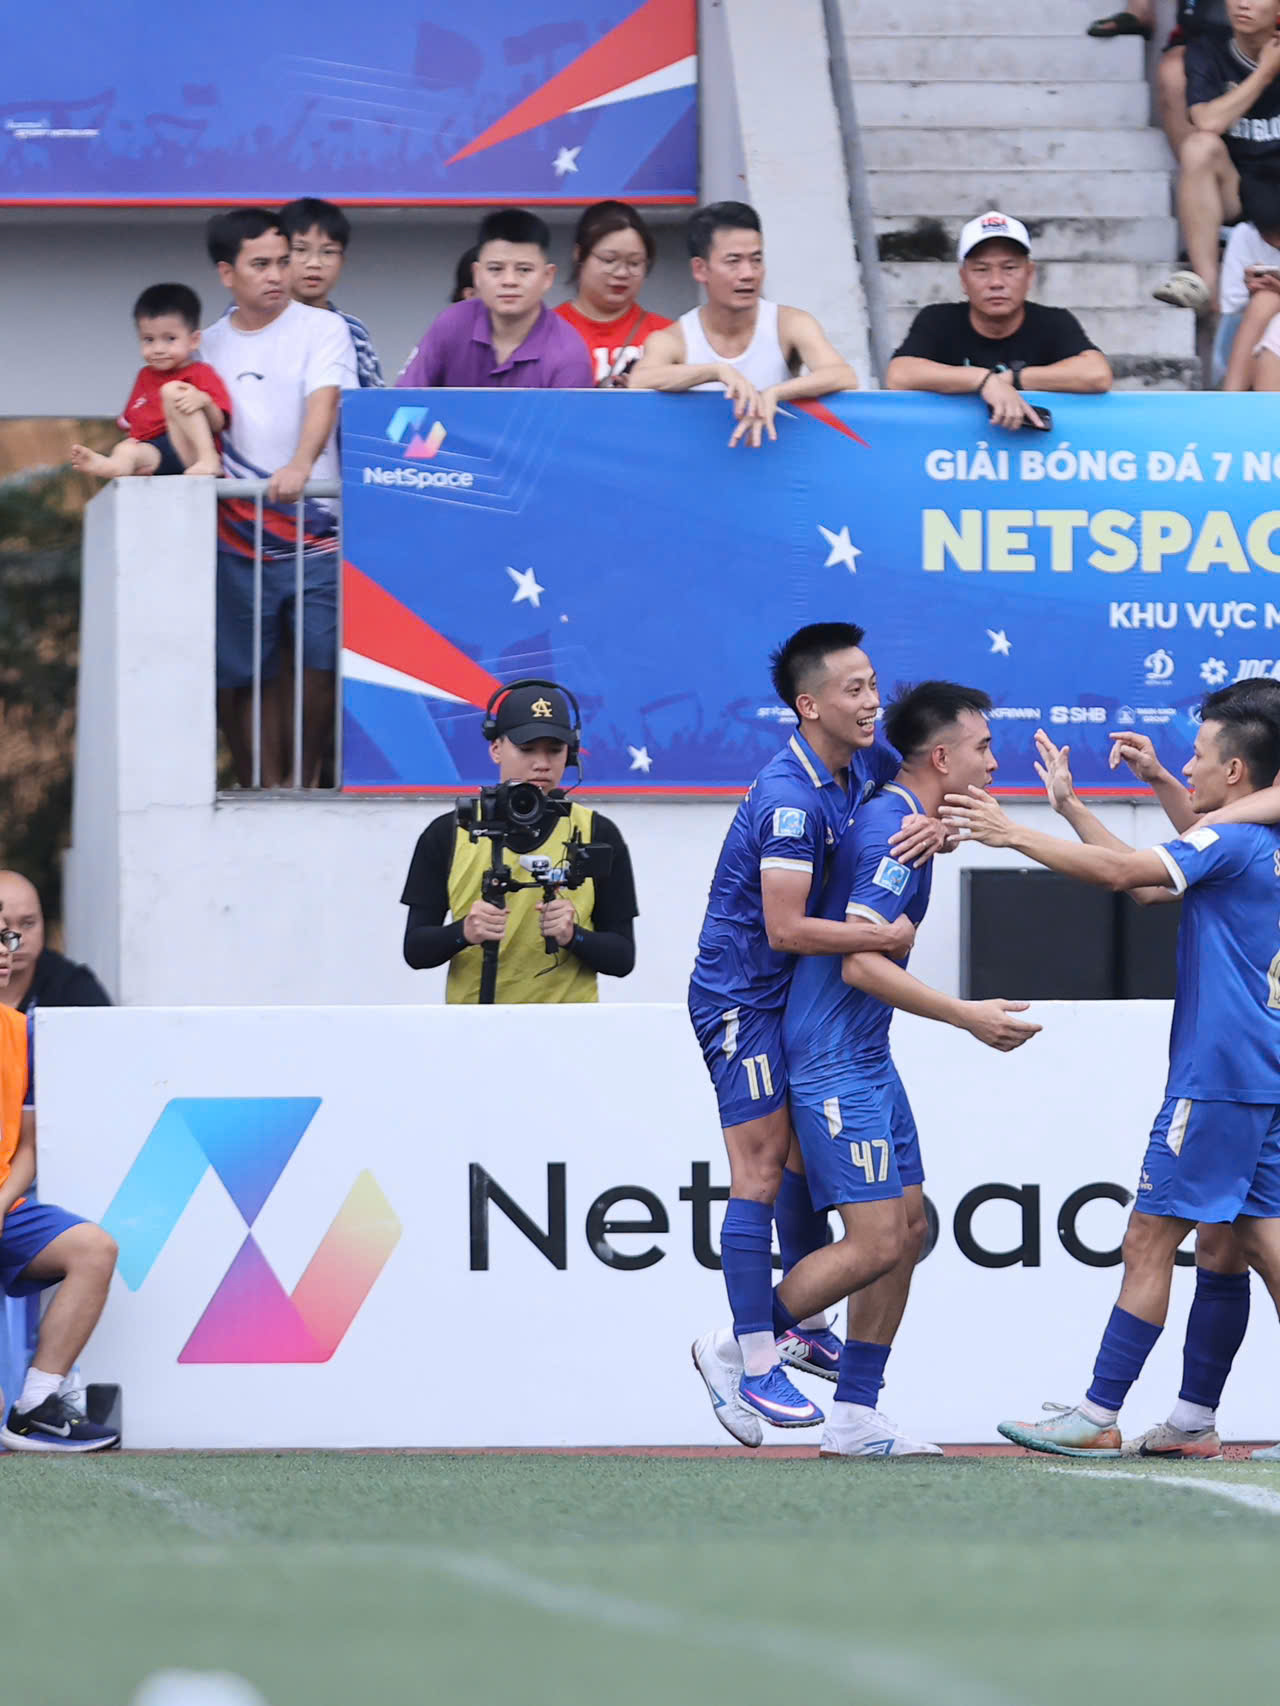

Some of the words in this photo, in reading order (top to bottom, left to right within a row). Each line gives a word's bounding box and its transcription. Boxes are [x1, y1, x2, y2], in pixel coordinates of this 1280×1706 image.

[363, 466, 474, 489] NetSpace
[926, 441, 1008, 481] GIẢI
[1021, 441, 1136, 482] BÓNG
[1147, 443, 1203, 482] ĐÁ
[1213, 452, 1232, 482] 7
[1110, 602, 1177, 629] KHU
[1186, 601, 1256, 637] VỰC
[1070, 707, 1106, 723] SHB
[742, 1053, 774, 1101] 11
[849, 1139, 889, 1184] 47
